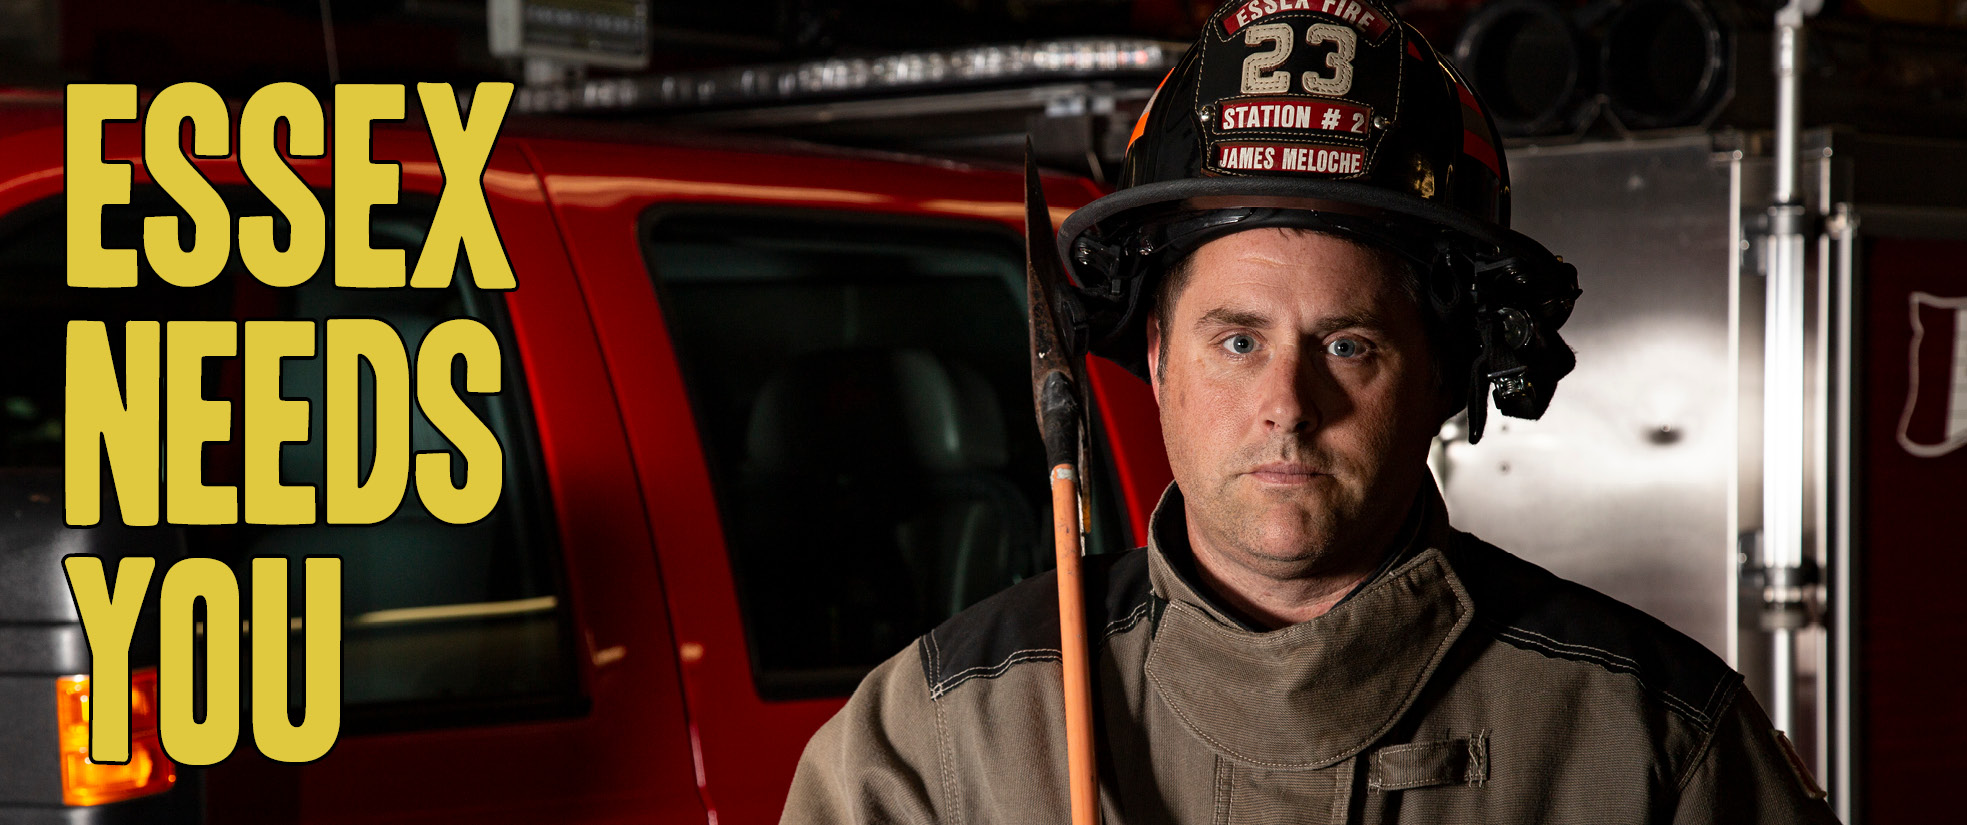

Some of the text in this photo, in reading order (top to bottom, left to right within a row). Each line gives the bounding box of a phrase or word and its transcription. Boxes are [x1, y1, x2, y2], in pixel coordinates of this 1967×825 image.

[1321, 0, 1376, 33] FIRE
[1241, 23, 1357, 95] 23
[1223, 104, 1365, 134] STATION # 2
[1218, 147, 1361, 174] JAMES MELOCHE
